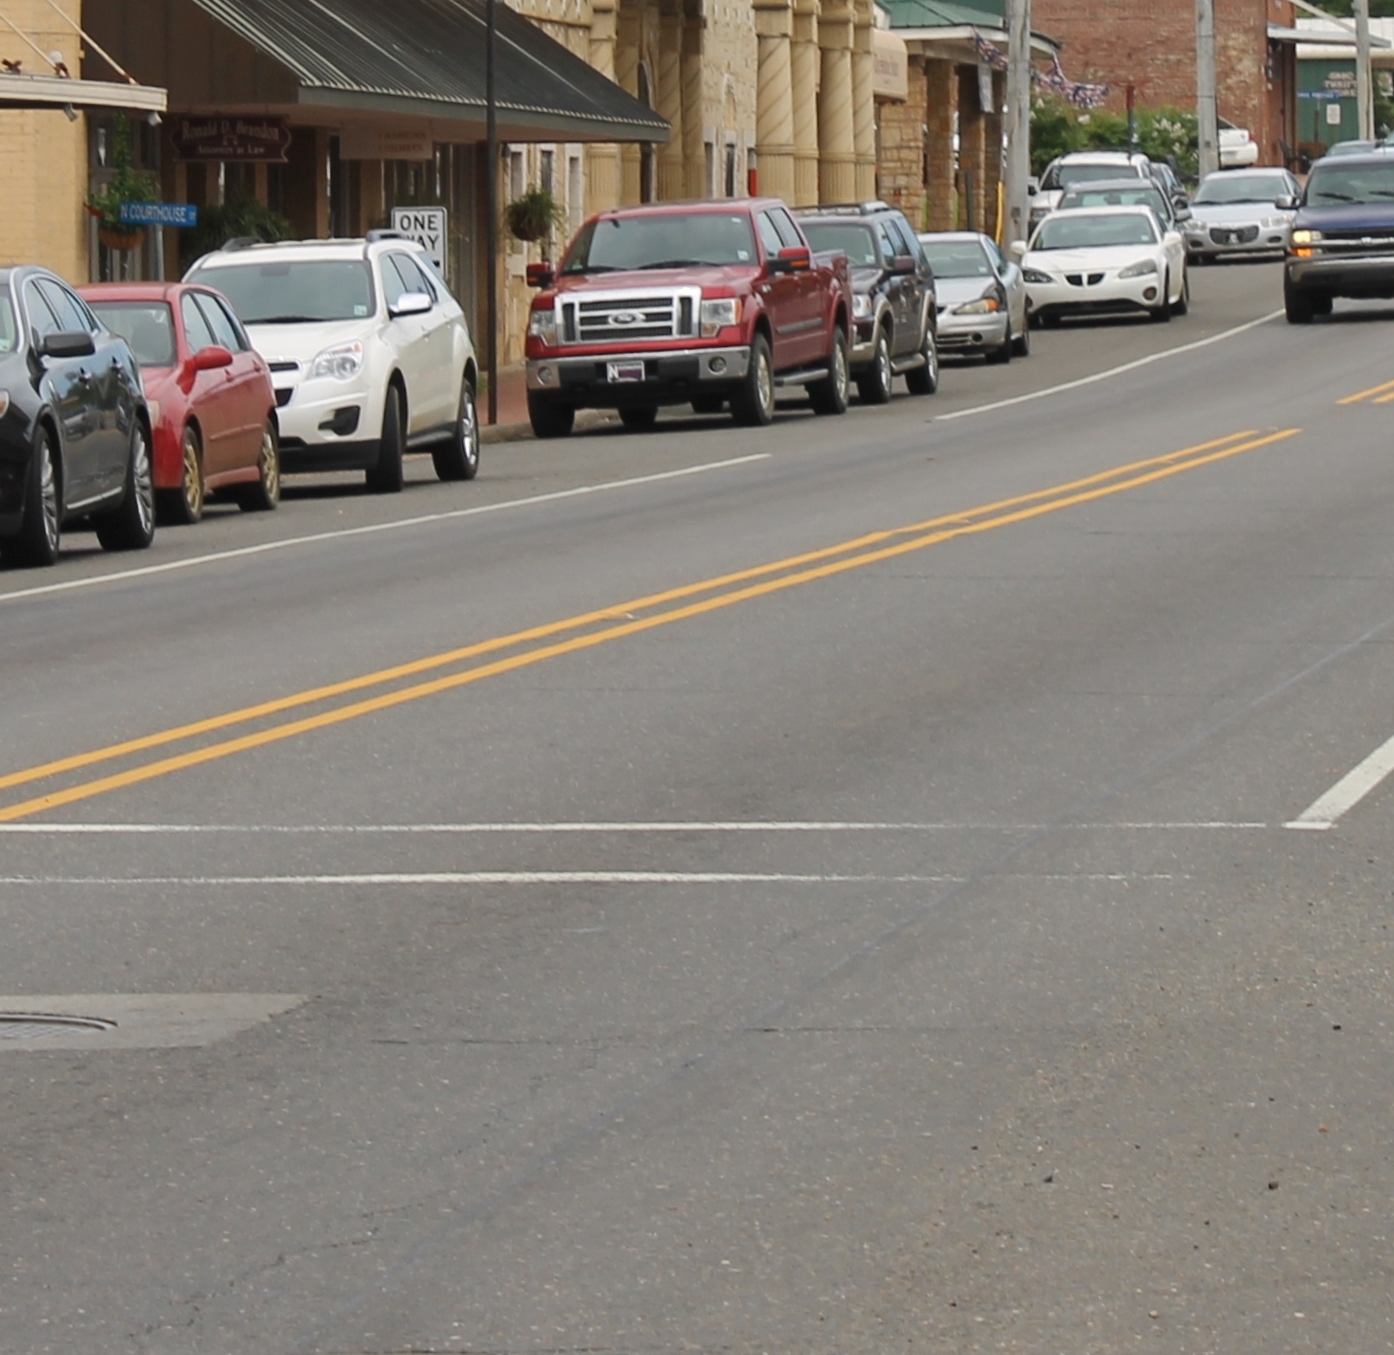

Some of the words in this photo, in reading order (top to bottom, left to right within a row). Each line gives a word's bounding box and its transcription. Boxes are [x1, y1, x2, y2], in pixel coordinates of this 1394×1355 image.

[236, 119, 279, 141] Brandon
[120, 204, 128, 218] N
[129, 204, 187, 223] COURTHOUSE
[399, 214, 439, 232] ONE
